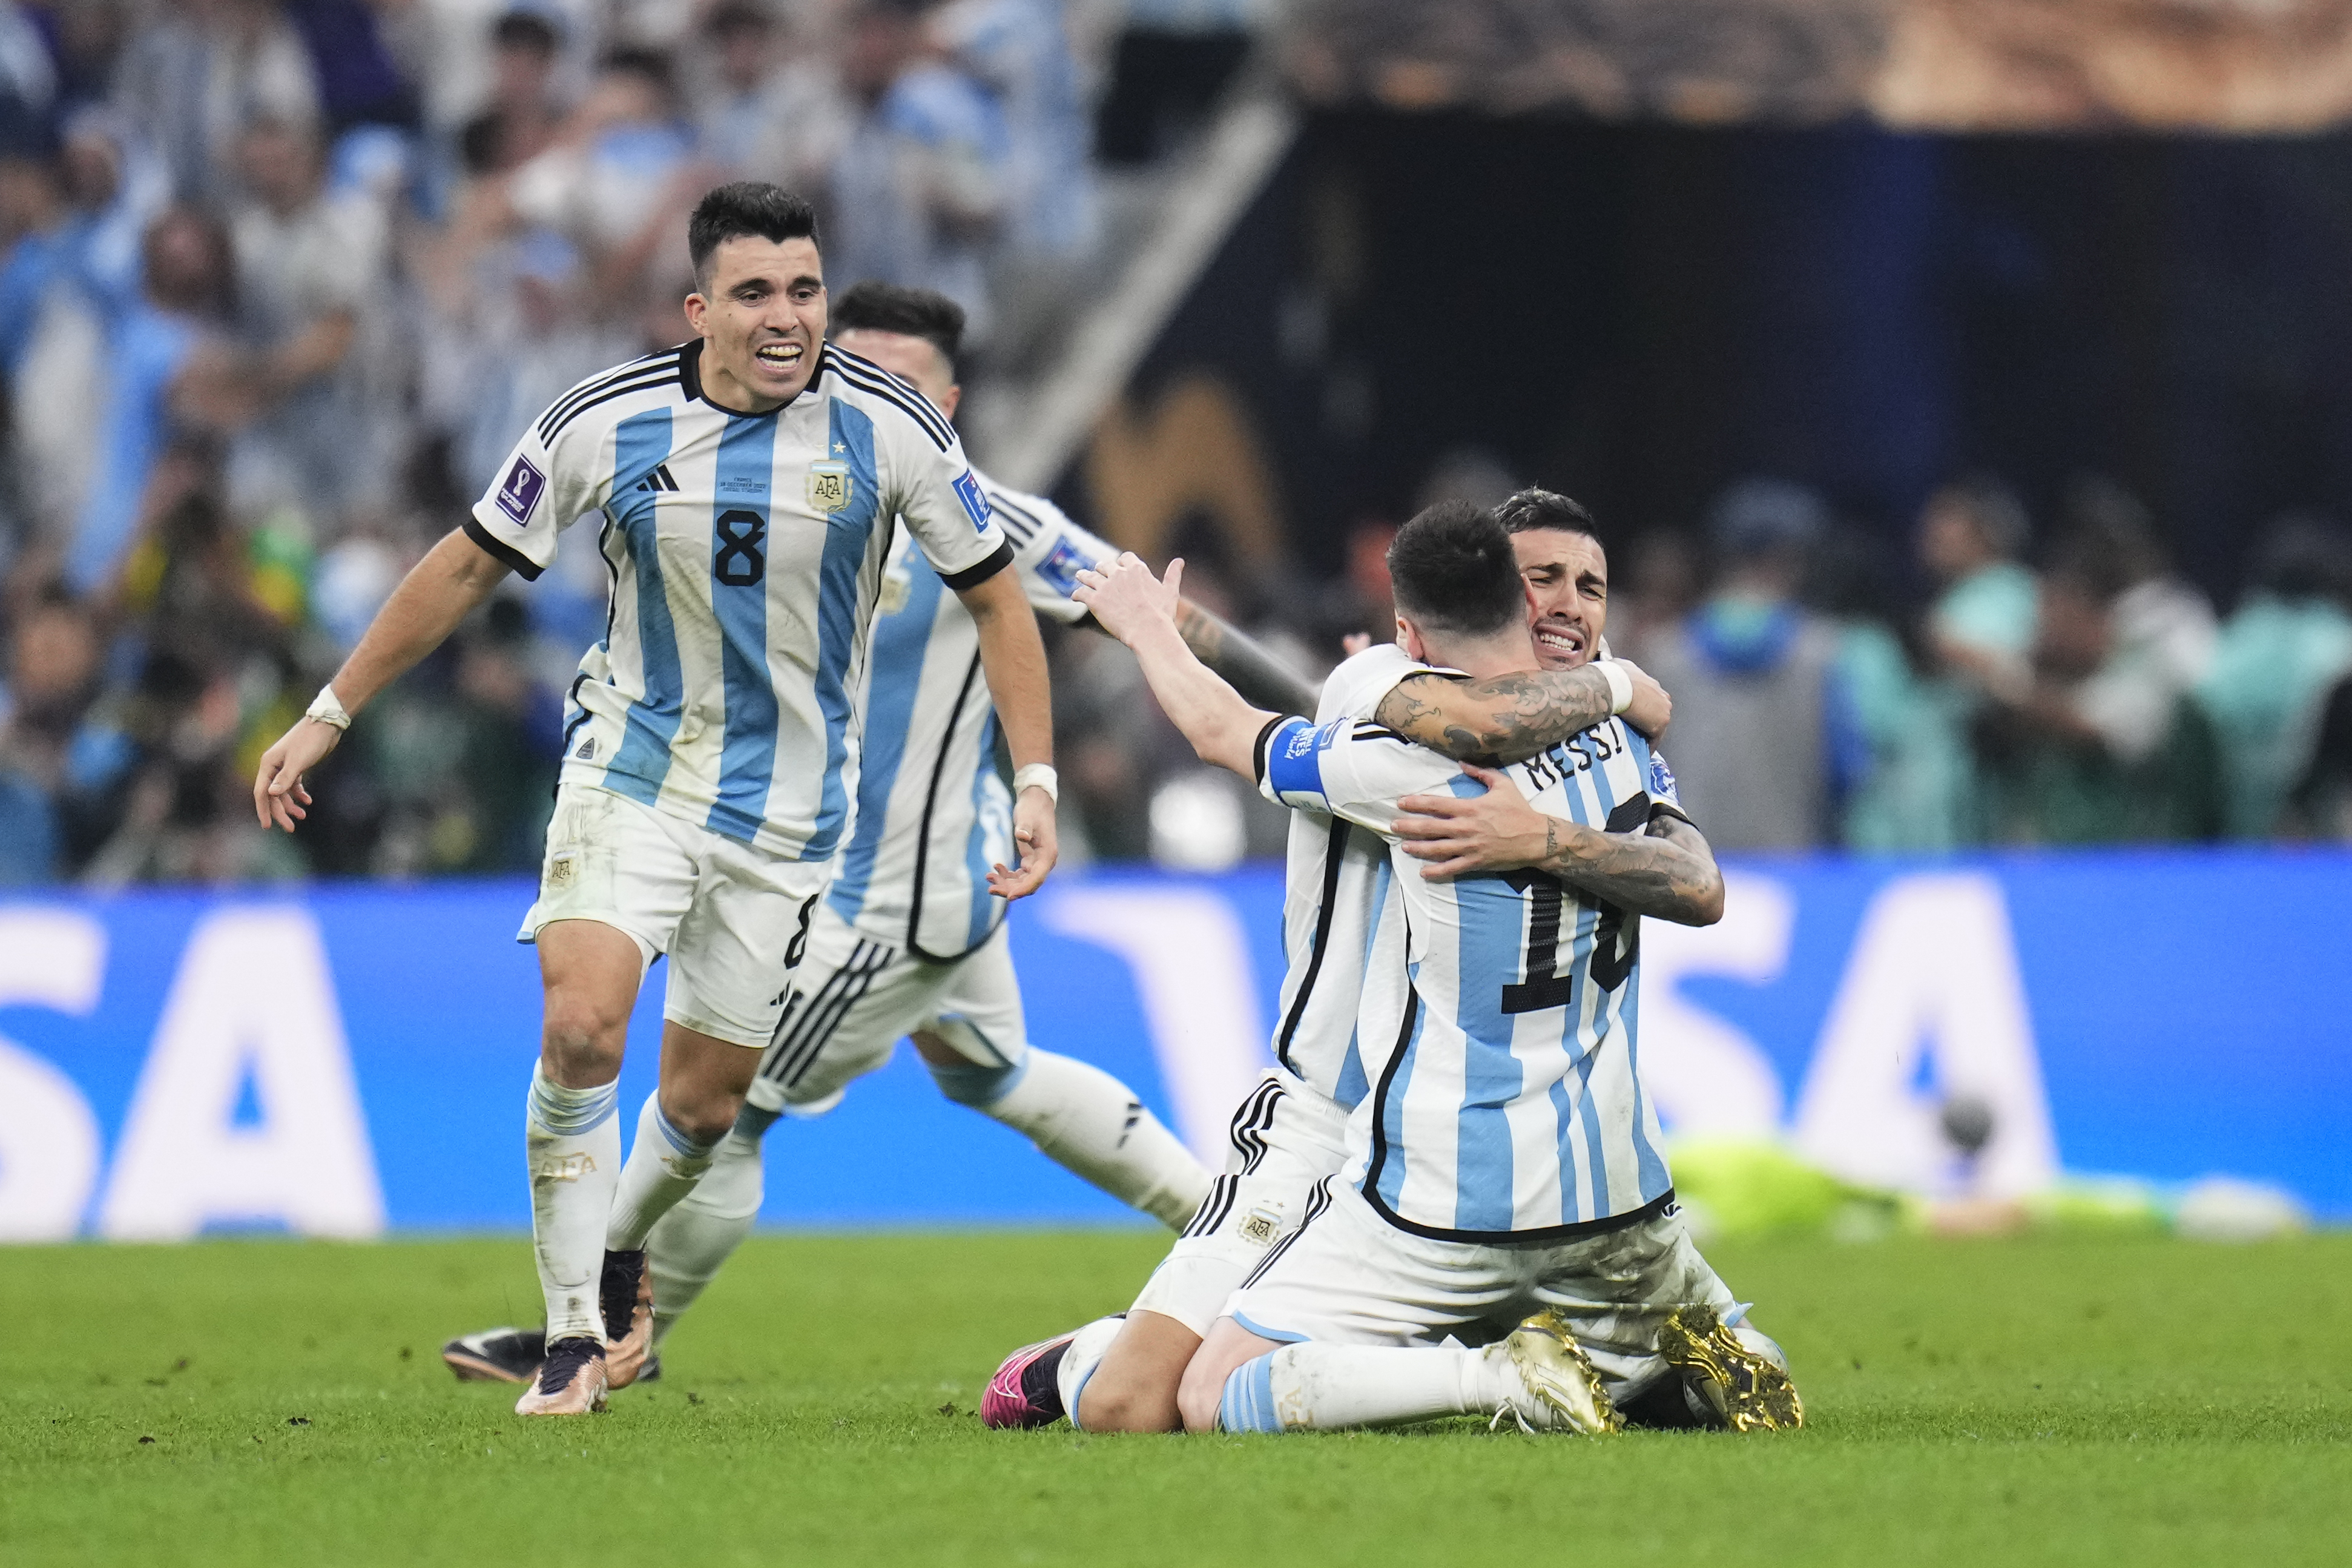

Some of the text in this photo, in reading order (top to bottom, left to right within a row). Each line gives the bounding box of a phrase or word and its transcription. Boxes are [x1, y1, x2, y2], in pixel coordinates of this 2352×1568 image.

[814, 474, 842, 499] AFA
[715, 510, 766, 587] 8
[1521, 717, 1624, 792] MESSI
[552, 860, 571, 880] AFA
[1500, 790, 1652, 1015] 10
[1247, 1217, 1271, 1237] AFA
[1279, 1385, 1313, 1428] FA
